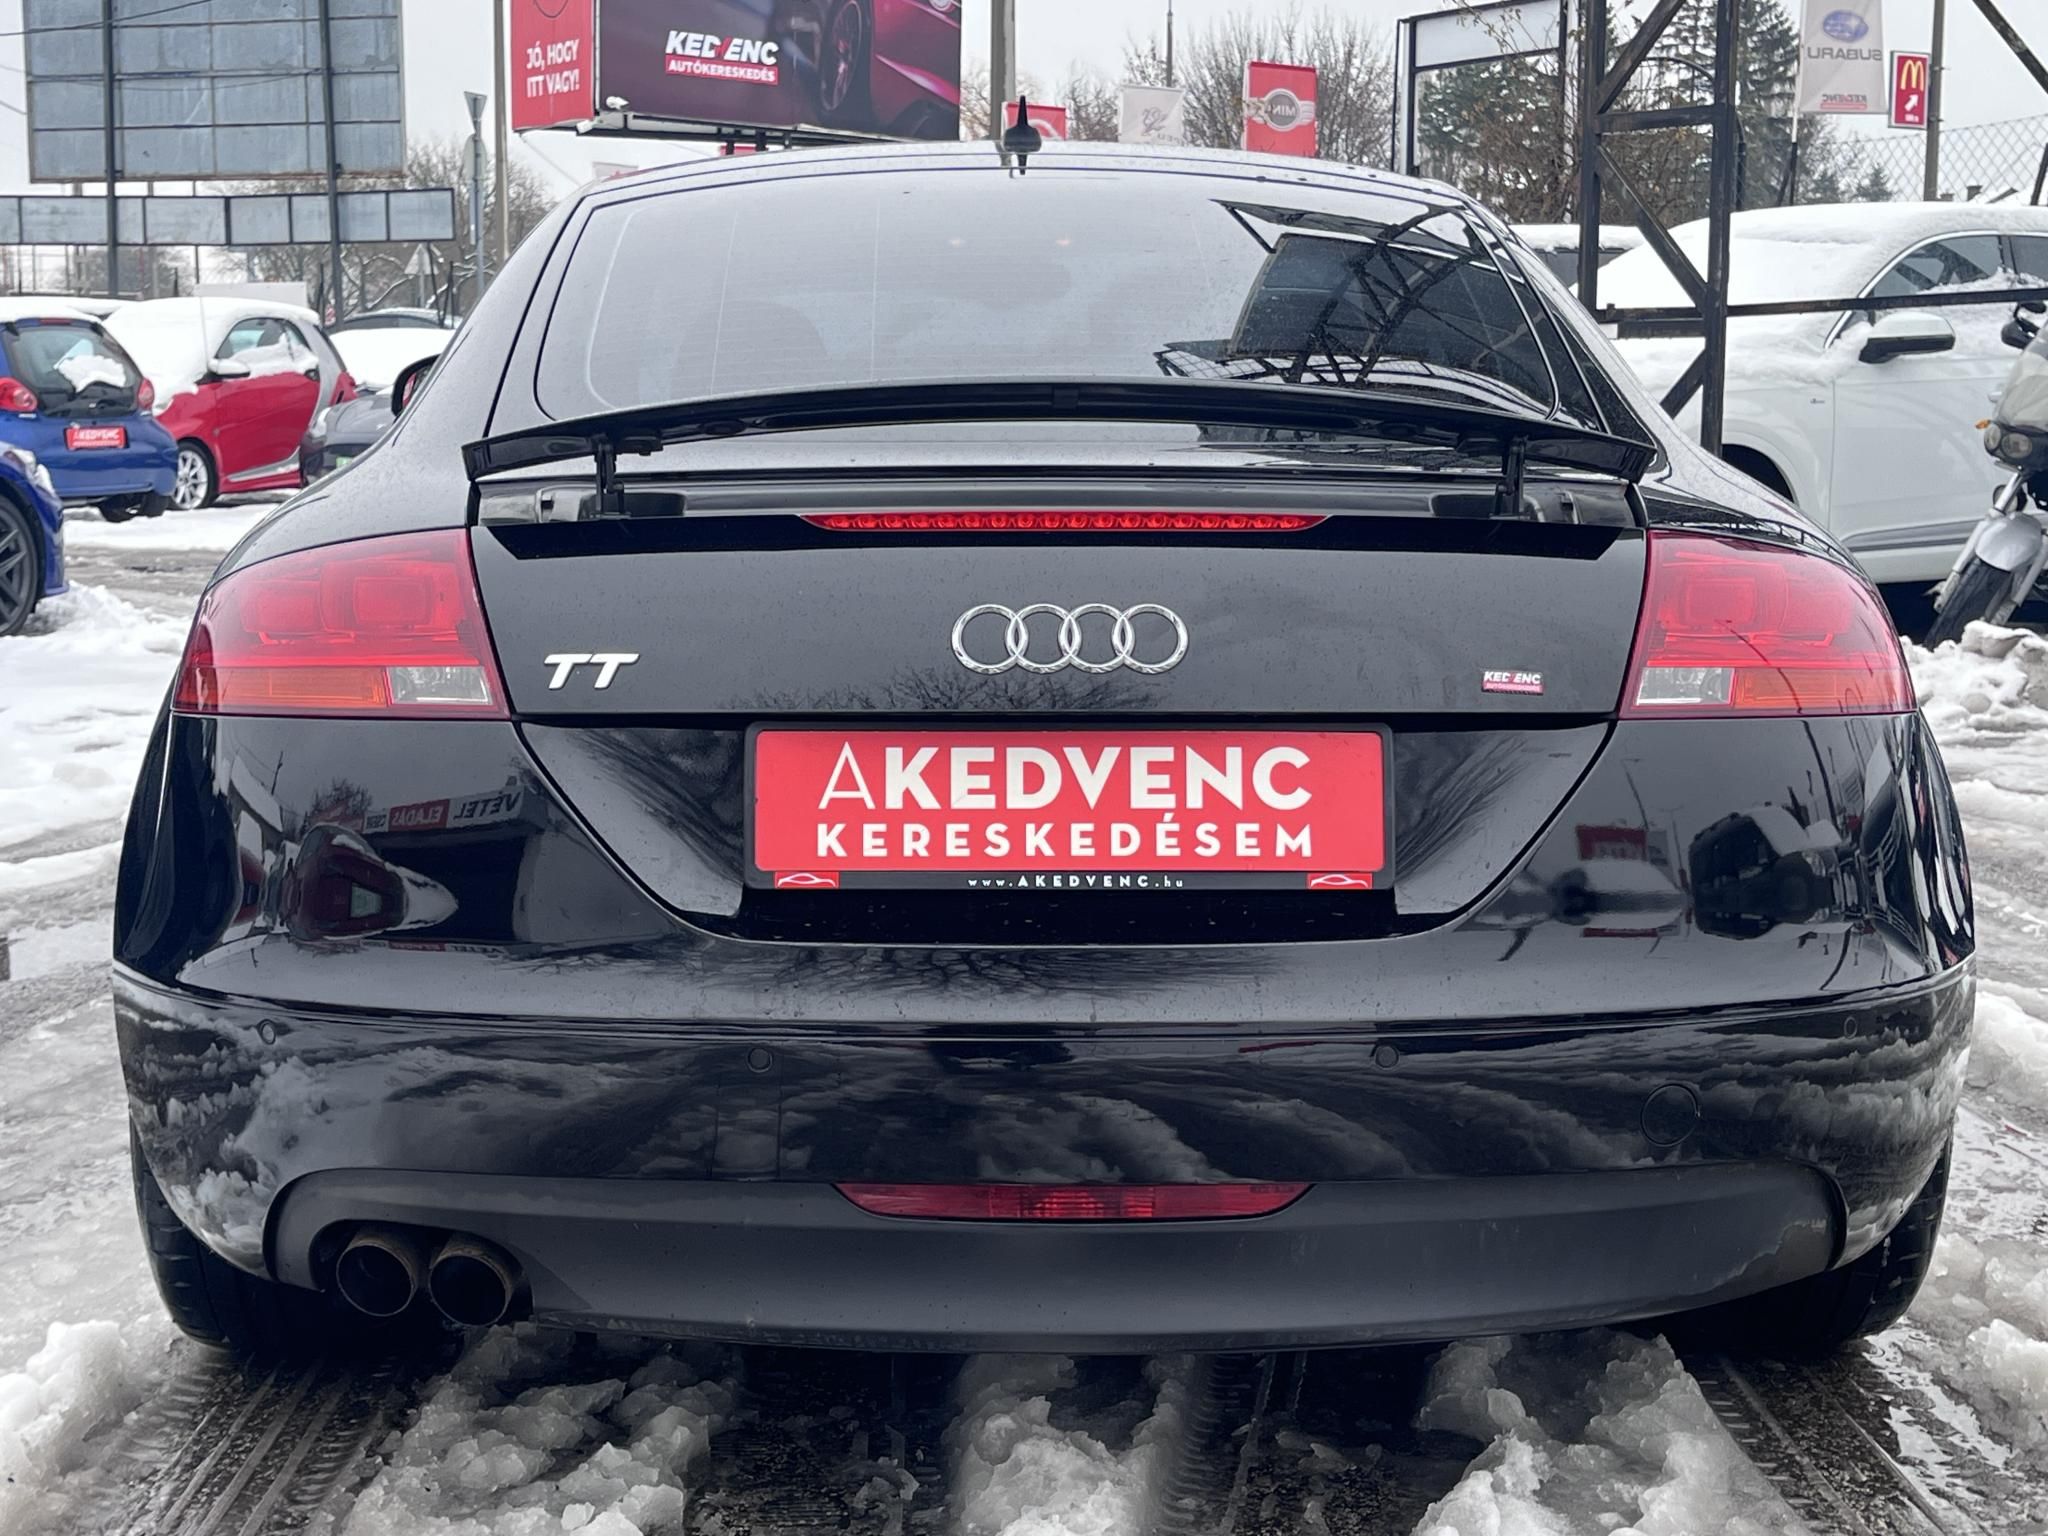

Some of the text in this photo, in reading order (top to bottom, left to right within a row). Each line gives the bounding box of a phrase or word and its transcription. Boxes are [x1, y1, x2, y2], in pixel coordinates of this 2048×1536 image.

[526, 39, 580, 71] JÓ, HOGY
[668, 59, 776, 82] AUTÓKERESKEDÉS
[527, 69, 580, 98] ITT VAGY!
[543, 653, 640, 689] TT
[818, 741, 1312, 811] AKEDVENC
[817, 812, 1312, 858] KERESKEDÉSEM
[967, 874, 1184, 889] www.AKEDVENC.hu
